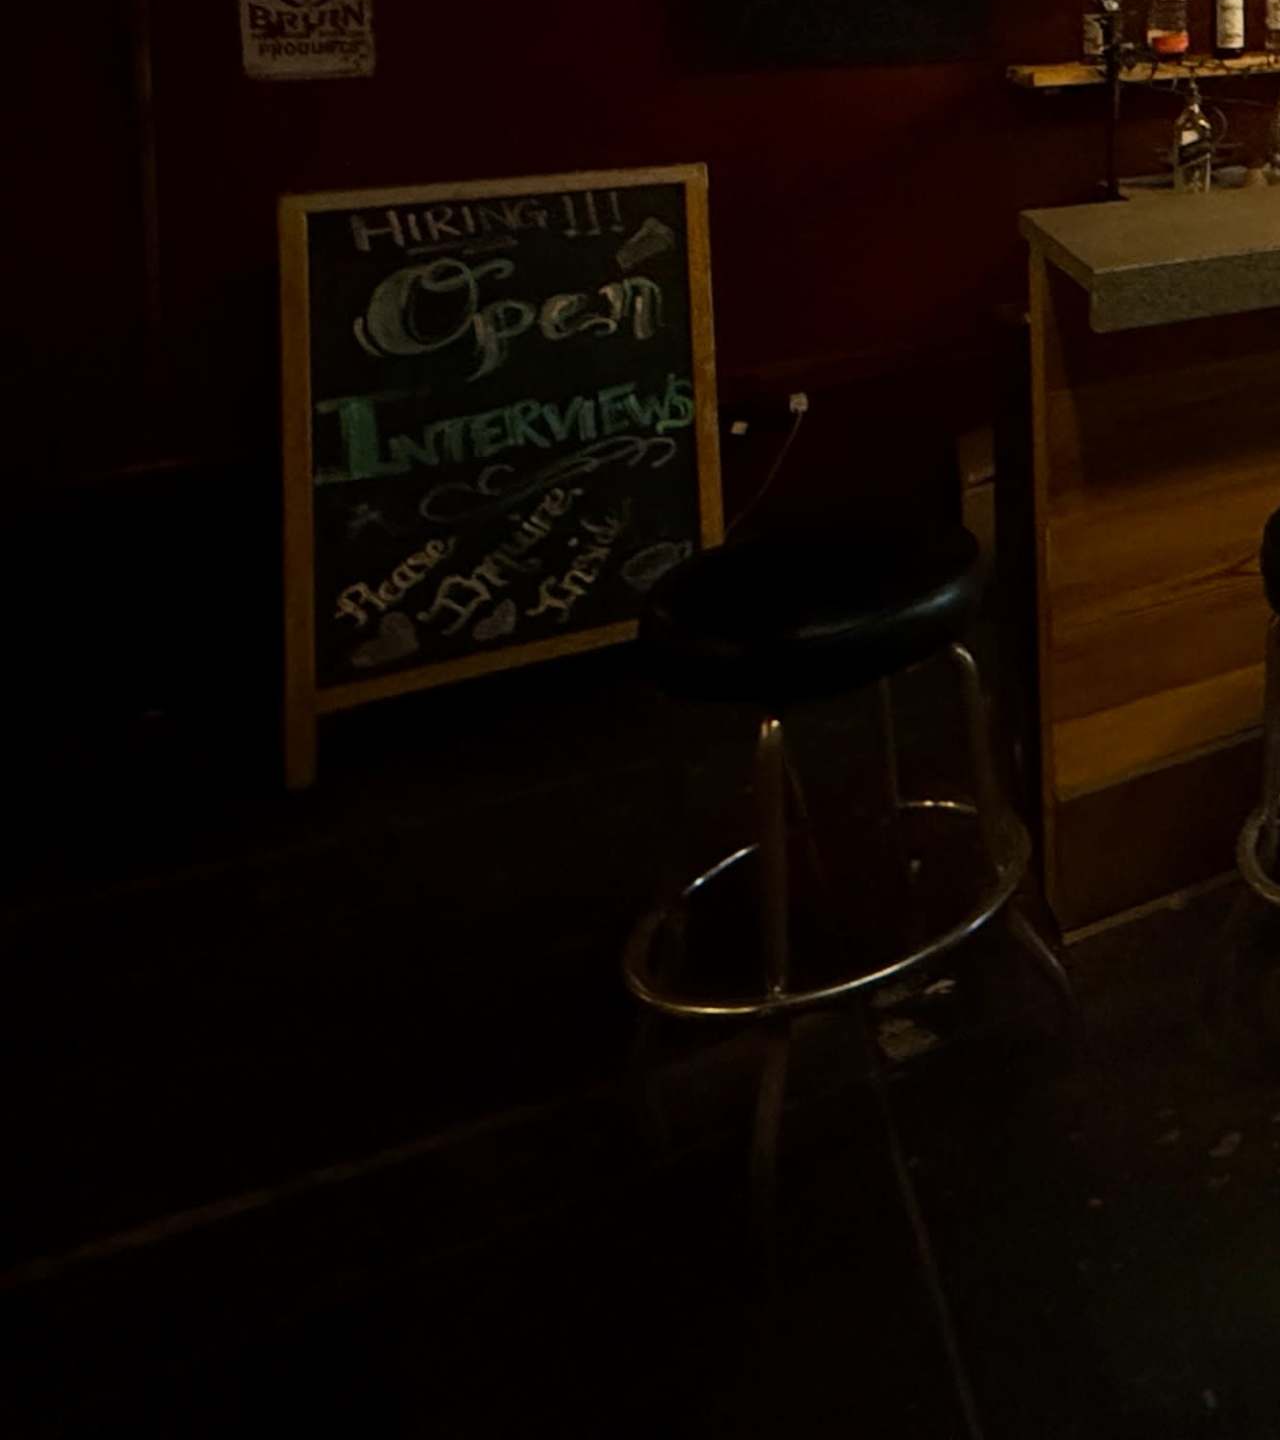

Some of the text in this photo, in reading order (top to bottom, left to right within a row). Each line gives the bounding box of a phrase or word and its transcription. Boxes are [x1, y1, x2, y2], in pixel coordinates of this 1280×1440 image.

[248, 0, 364, 35] BRUIN
[349, 201, 548, 252] HIRING
[352, 257, 668, 384] Open
